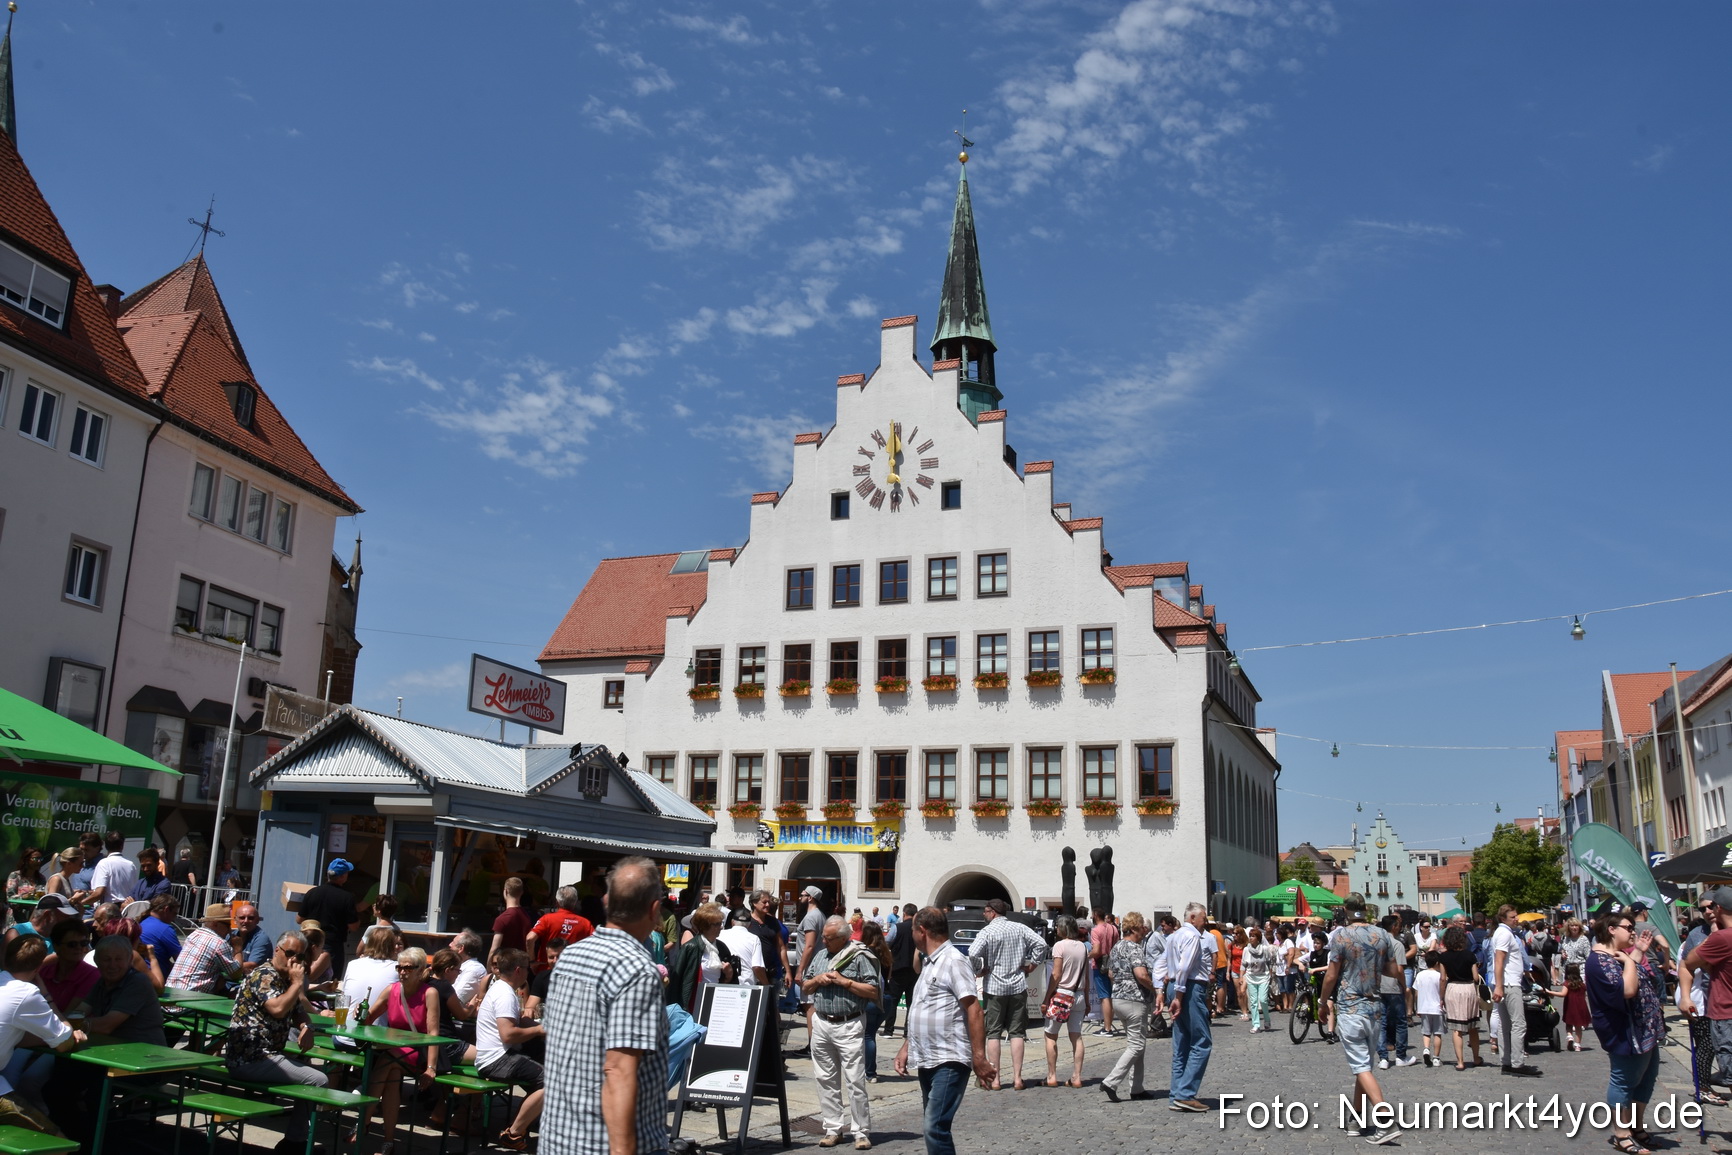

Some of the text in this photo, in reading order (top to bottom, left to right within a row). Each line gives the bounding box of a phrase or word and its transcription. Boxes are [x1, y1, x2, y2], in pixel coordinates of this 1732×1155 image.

[484, 672, 551, 714] Lehmeier's
[275, 698, 322, 729] Parc Ferm
[525, 704, 551, 721] IMBISS
[6, 793, 142, 819] Verantwortung leben.
[2, 812, 110, 834] Genuss schaffen.
[777, 824, 874, 846] ANMELDUNG
[667, 863, 689, 878] WC
